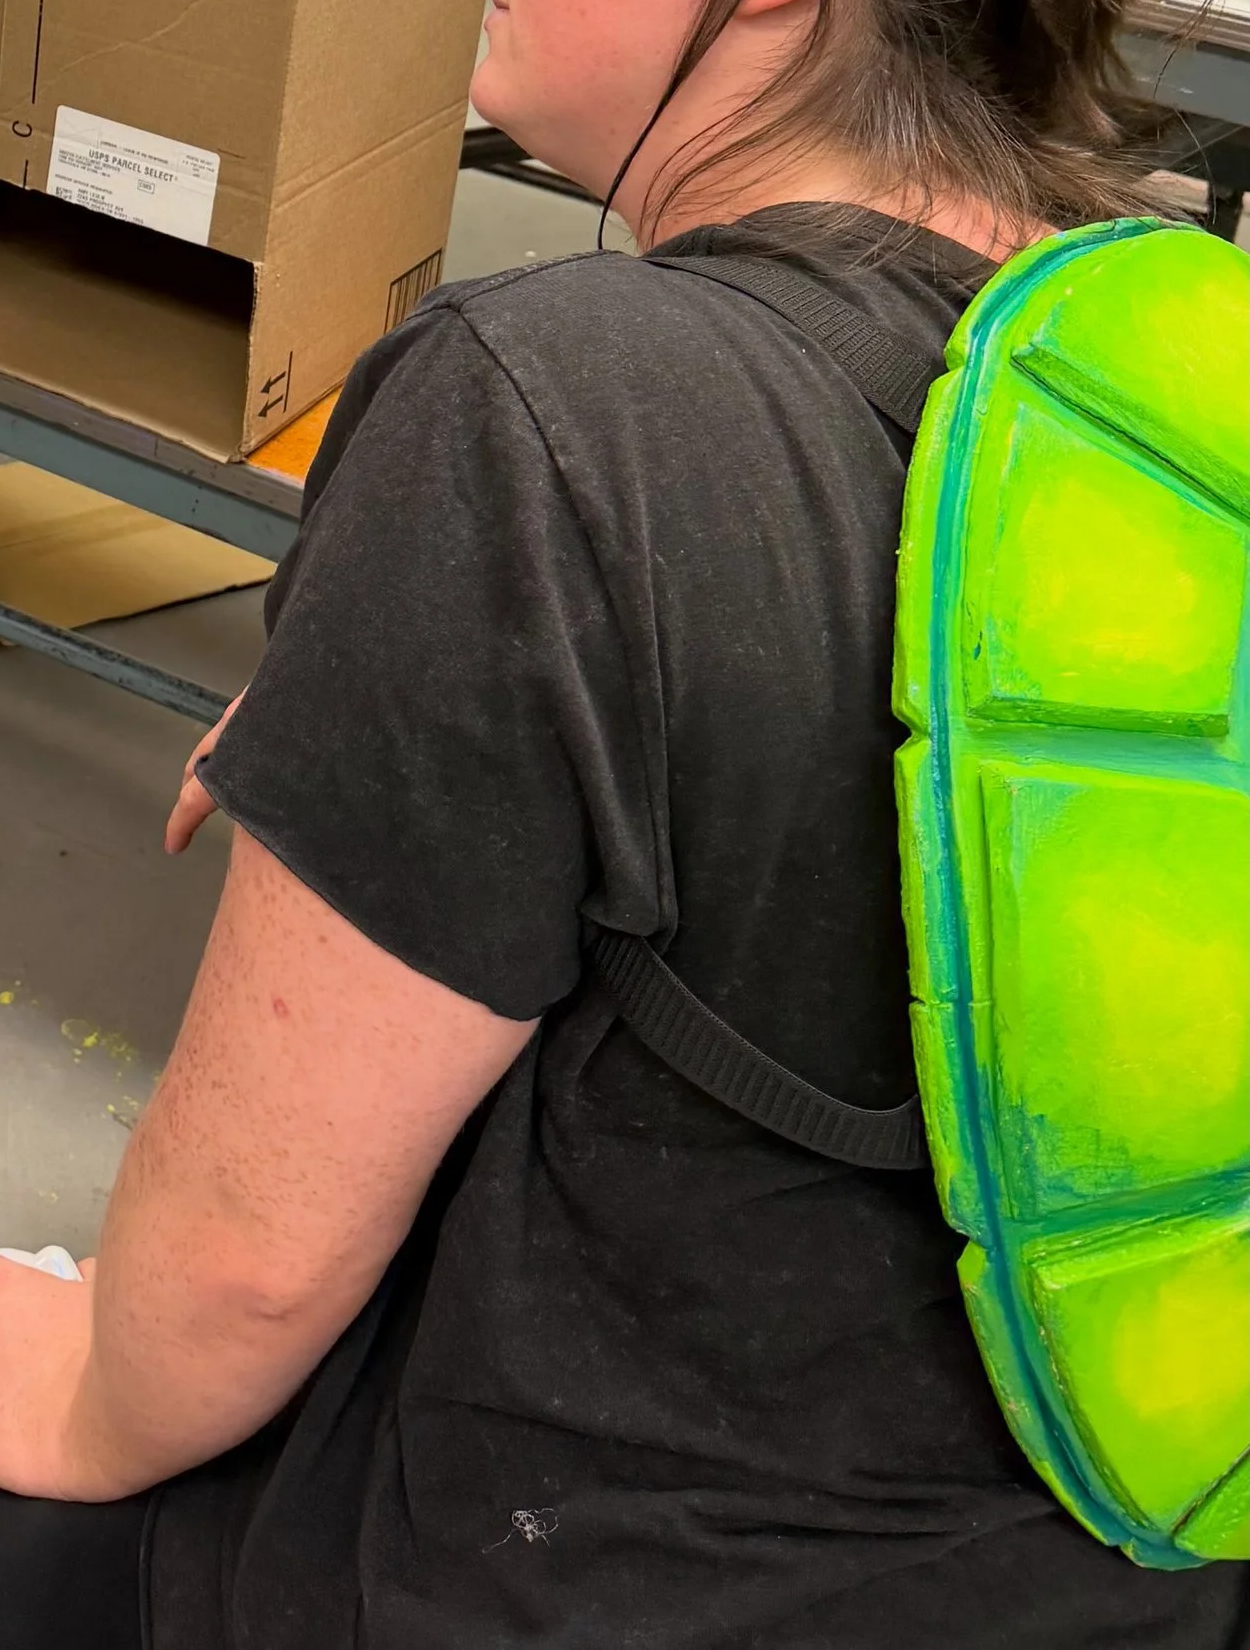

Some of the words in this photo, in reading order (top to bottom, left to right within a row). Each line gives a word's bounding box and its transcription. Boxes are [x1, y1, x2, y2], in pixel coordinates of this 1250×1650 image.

[88, 149, 110, 163] USPS
[111, 156, 142, 174] PARCEL
[144, 166, 174, 182] SELECT
